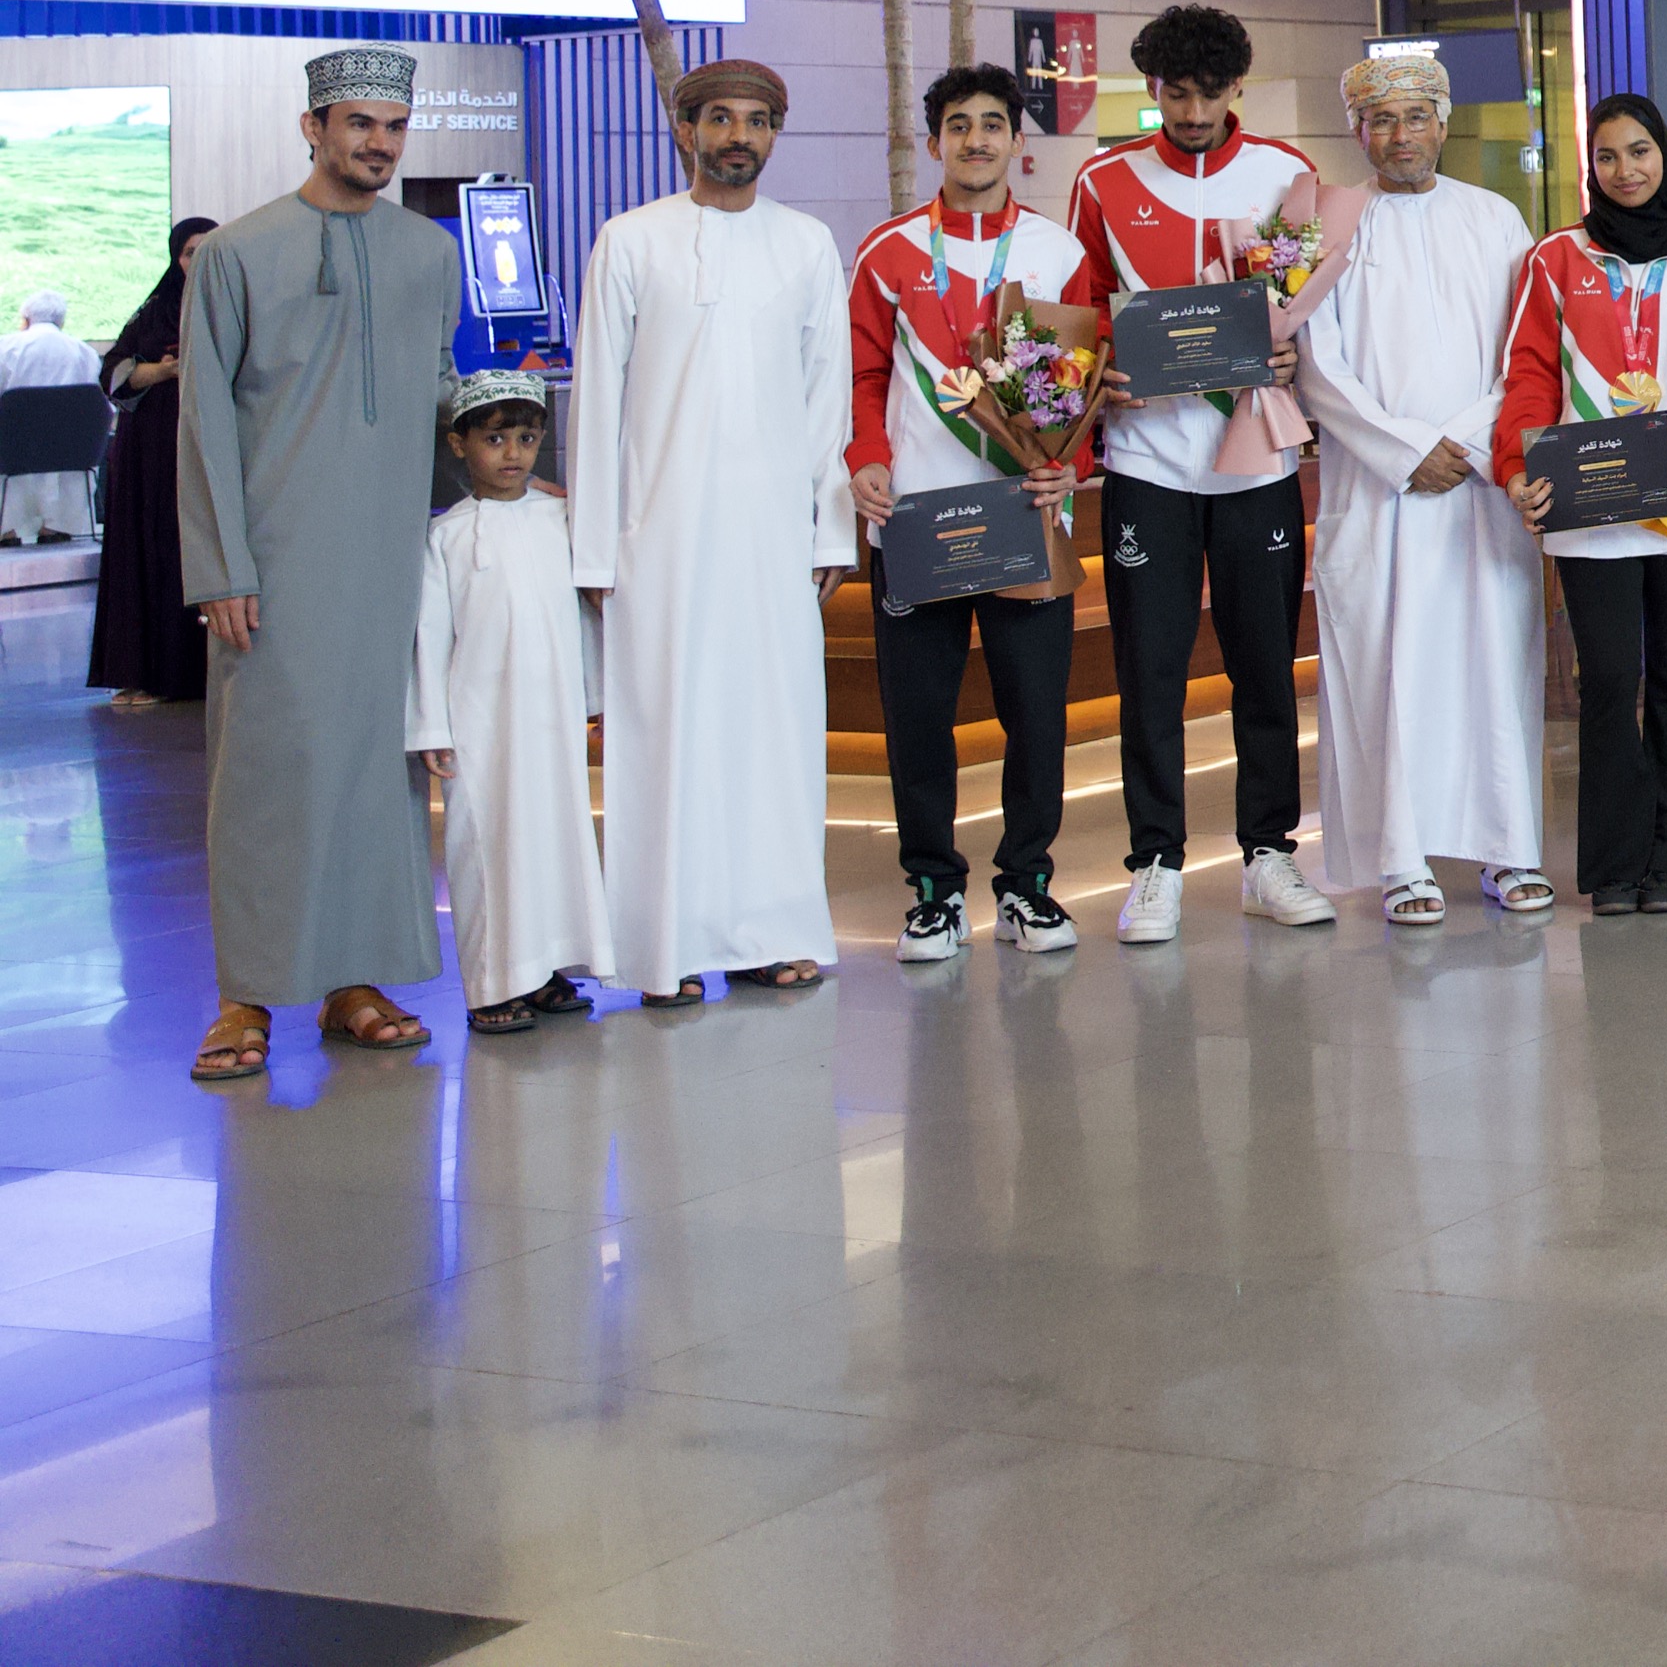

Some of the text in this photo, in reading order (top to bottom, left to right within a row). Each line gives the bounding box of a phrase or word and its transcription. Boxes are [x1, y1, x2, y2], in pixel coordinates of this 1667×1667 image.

[460, 89, 518, 108] الخدمة
[446, 114, 518, 130] SERVICE
[1196, 304, 1221, 316] شهادة
[1599, 438, 1623, 449] شهادة
[957, 504, 983, 516] شهادة
